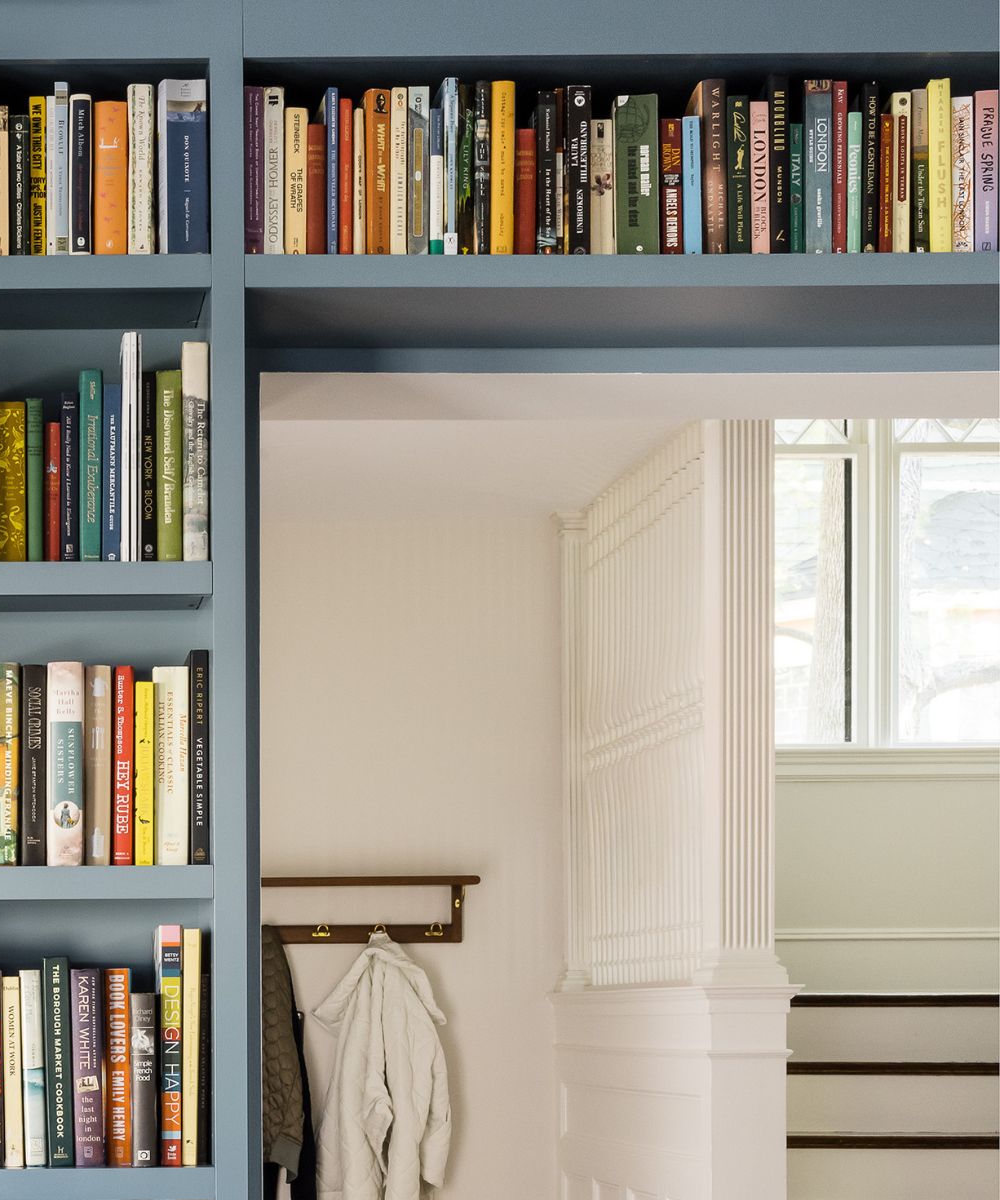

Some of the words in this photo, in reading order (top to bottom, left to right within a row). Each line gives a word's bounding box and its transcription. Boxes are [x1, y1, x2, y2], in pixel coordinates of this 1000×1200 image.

[32, 104, 41, 116] WE
[32, 117, 41, 135] OWN
[774, 91, 785, 151] MOONBLIND
[981, 107, 994, 146] PRAGUE
[32, 136, 41, 152] THIS
[711, 87, 720, 173] WARLIGHT
[817, 118, 827, 172] LONDON
[33, 154, 42, 170] CITY
[580, 121, 588, 182] HILLENBRAND
[754, 130, 766, 202] LONDON
[791, 153, 800, 186] ITALY
[290, 172, 296, 182] OF
[981, 153, 994, 192] SPRING
[196, 667, 204, 688] ERIC
[196, 692, 204, 725] RIPERT
[57, 739, 65, 784] SISTERS
[67, 728, 75, 794] SUNFLOWER
[116, 760, 130, 790] HEY
[116, 794, 129, 834] RUBE
[52, 965, 60, 984] THE
[109, 974, 125, 1010] BOOK
[53, 987, 61, 1035] BOROUGH
[165, 985, 179, 1054] DESIGN
[110, 1014, 125, 1063] LOVERS
[112, 1071, 125, 1103] EMILY
[165, 1064, 179, 1126] HAPPY
[56, 1083, 64, 1138] COOKBOOK
[113, 1107, 125, 1141] HENRY
